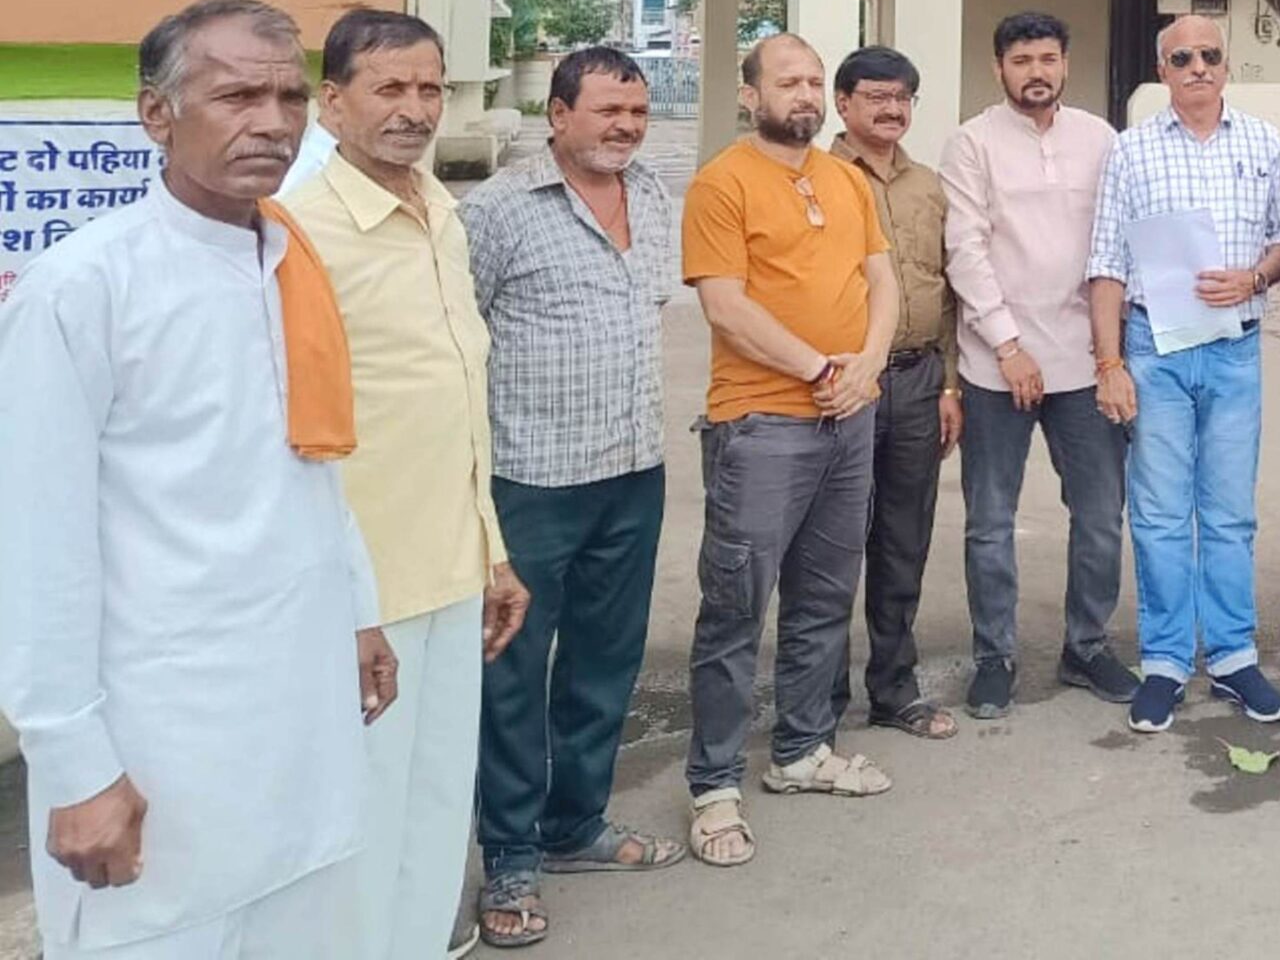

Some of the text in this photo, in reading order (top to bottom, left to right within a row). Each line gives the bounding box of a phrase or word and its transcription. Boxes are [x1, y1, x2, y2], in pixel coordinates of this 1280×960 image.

[25, 140, 61, 172] दो
[67, 140, 152, 174] पहिया
[25, 188, 72, 210] का
